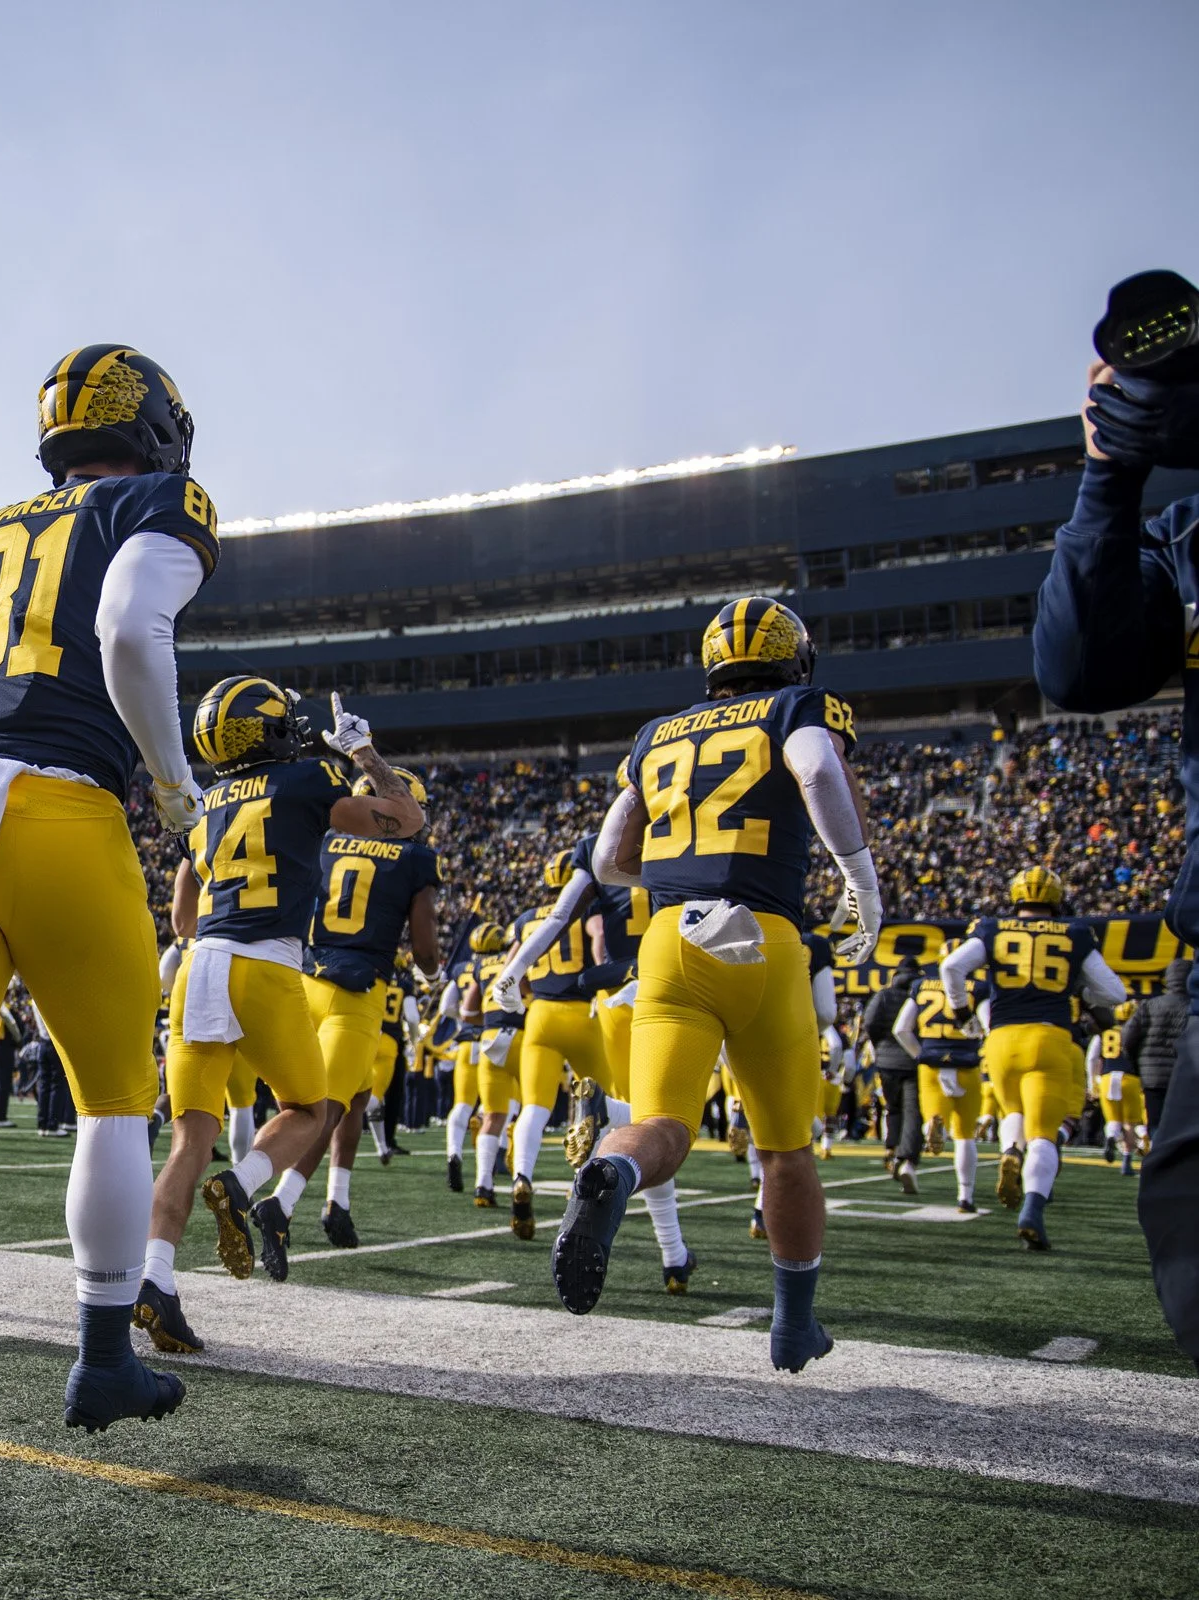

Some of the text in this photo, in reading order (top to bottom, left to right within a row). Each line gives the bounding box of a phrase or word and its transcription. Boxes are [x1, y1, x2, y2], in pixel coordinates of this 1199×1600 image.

[651, 697, 775, 747] BREDESON
[824, 693, 859, 742] 82
[203, 774, 268, 813] WILSON
[642, 725, 772, 863] 82
[188, 797, 278, 918] 14
[328, 837, 403, 860] CLEMONS
[322, 856, 377, 935] 0
[993, 930, 1073, 994] 96
